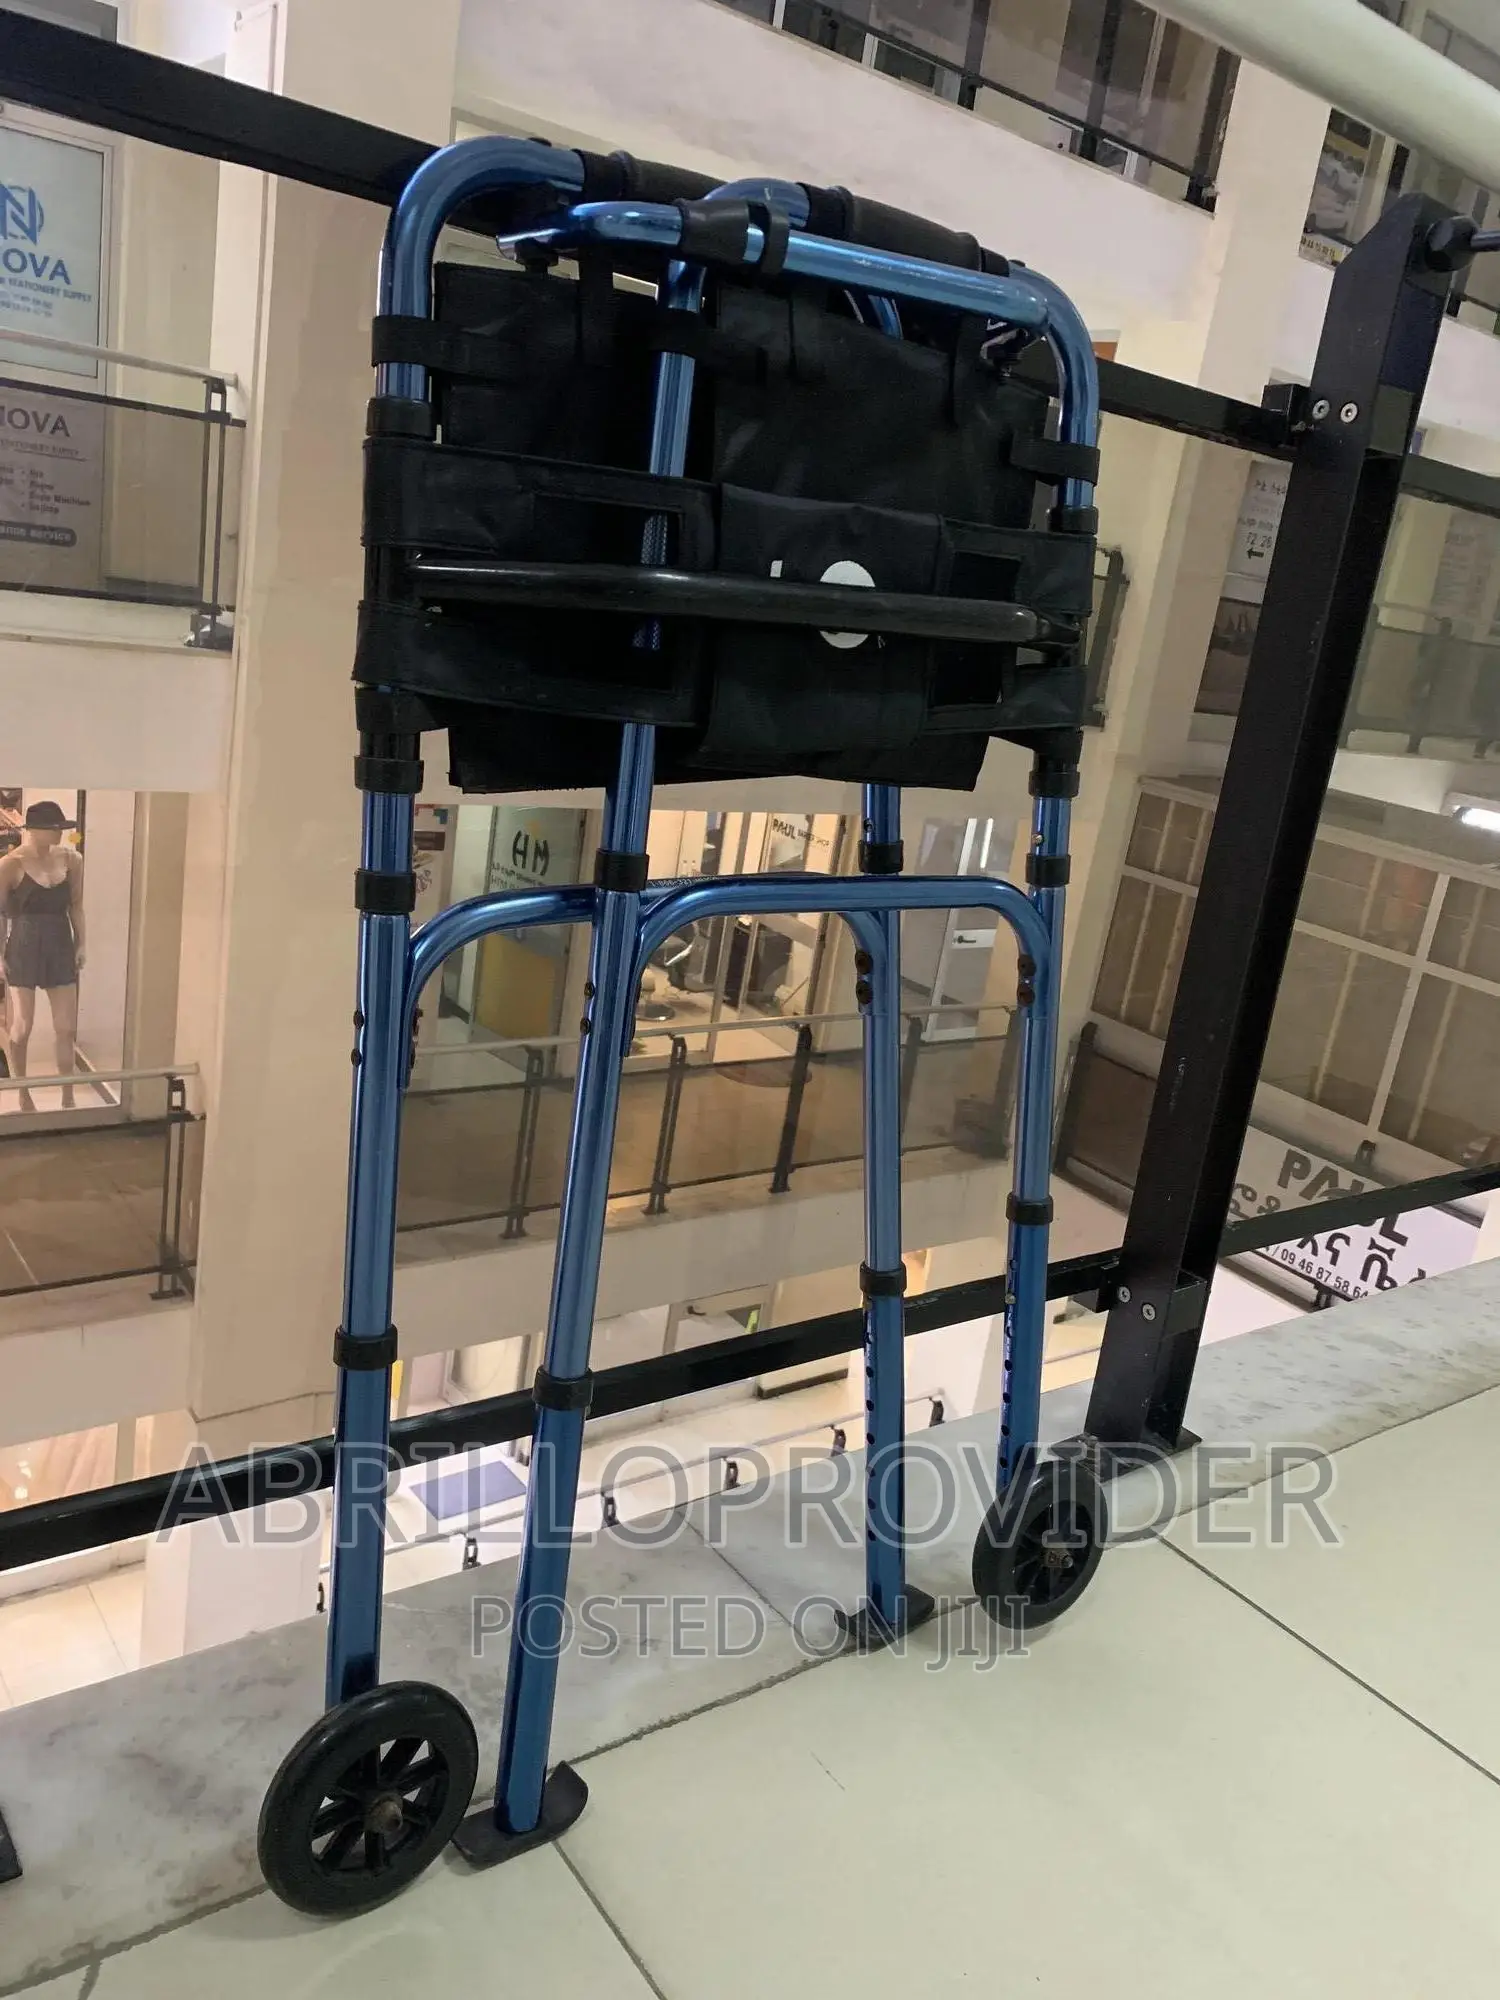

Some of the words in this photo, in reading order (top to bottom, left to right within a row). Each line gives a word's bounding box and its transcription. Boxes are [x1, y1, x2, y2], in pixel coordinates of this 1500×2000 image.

[0, 406, 70, 437] OVA
[772, 818, 796, 840] PAUL
[1280, 1247, 1296, 1265] 09
[1298, 1258, 1314, 1276] 46
[1315, 1266, 1333, 1283] 87
[1333, 1277, 1351, 1294] 58
